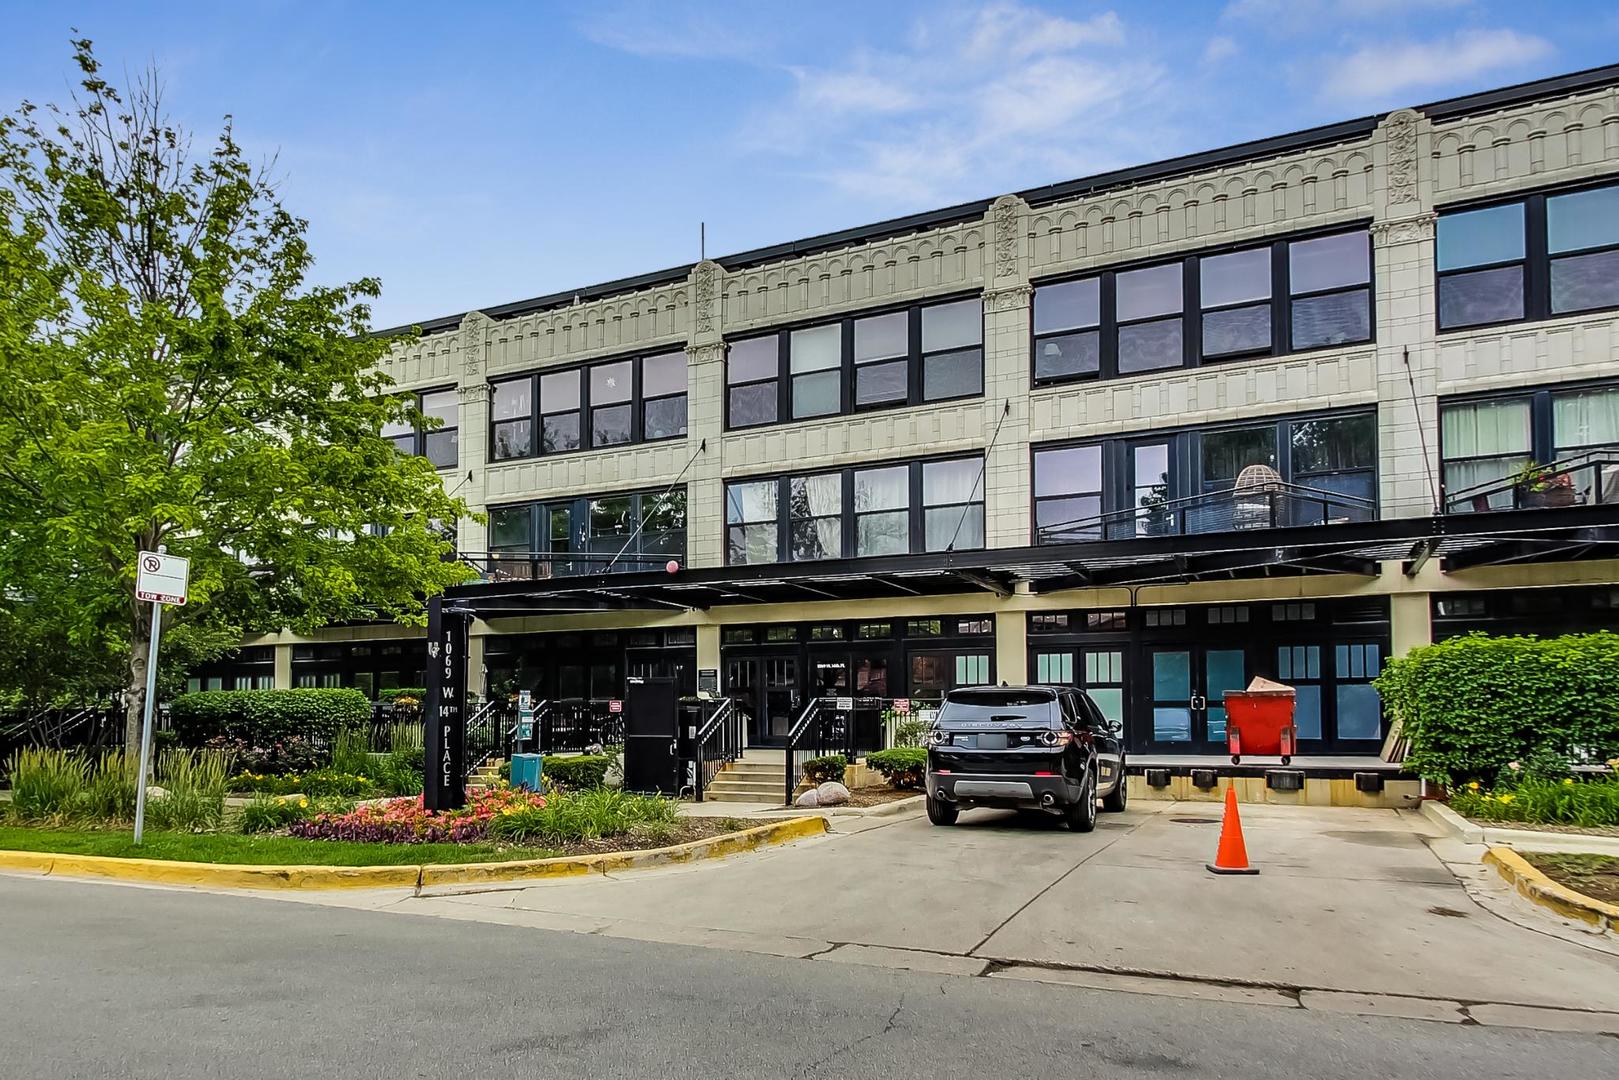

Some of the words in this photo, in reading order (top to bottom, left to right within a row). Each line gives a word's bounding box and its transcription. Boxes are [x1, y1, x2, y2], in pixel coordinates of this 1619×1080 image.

[141, 591, 157, 600] TOW
[445, 630, 453, 679] 1069
[439, 705, 458, 717] 14TH
[442, 725, 451, 787] PLACE
